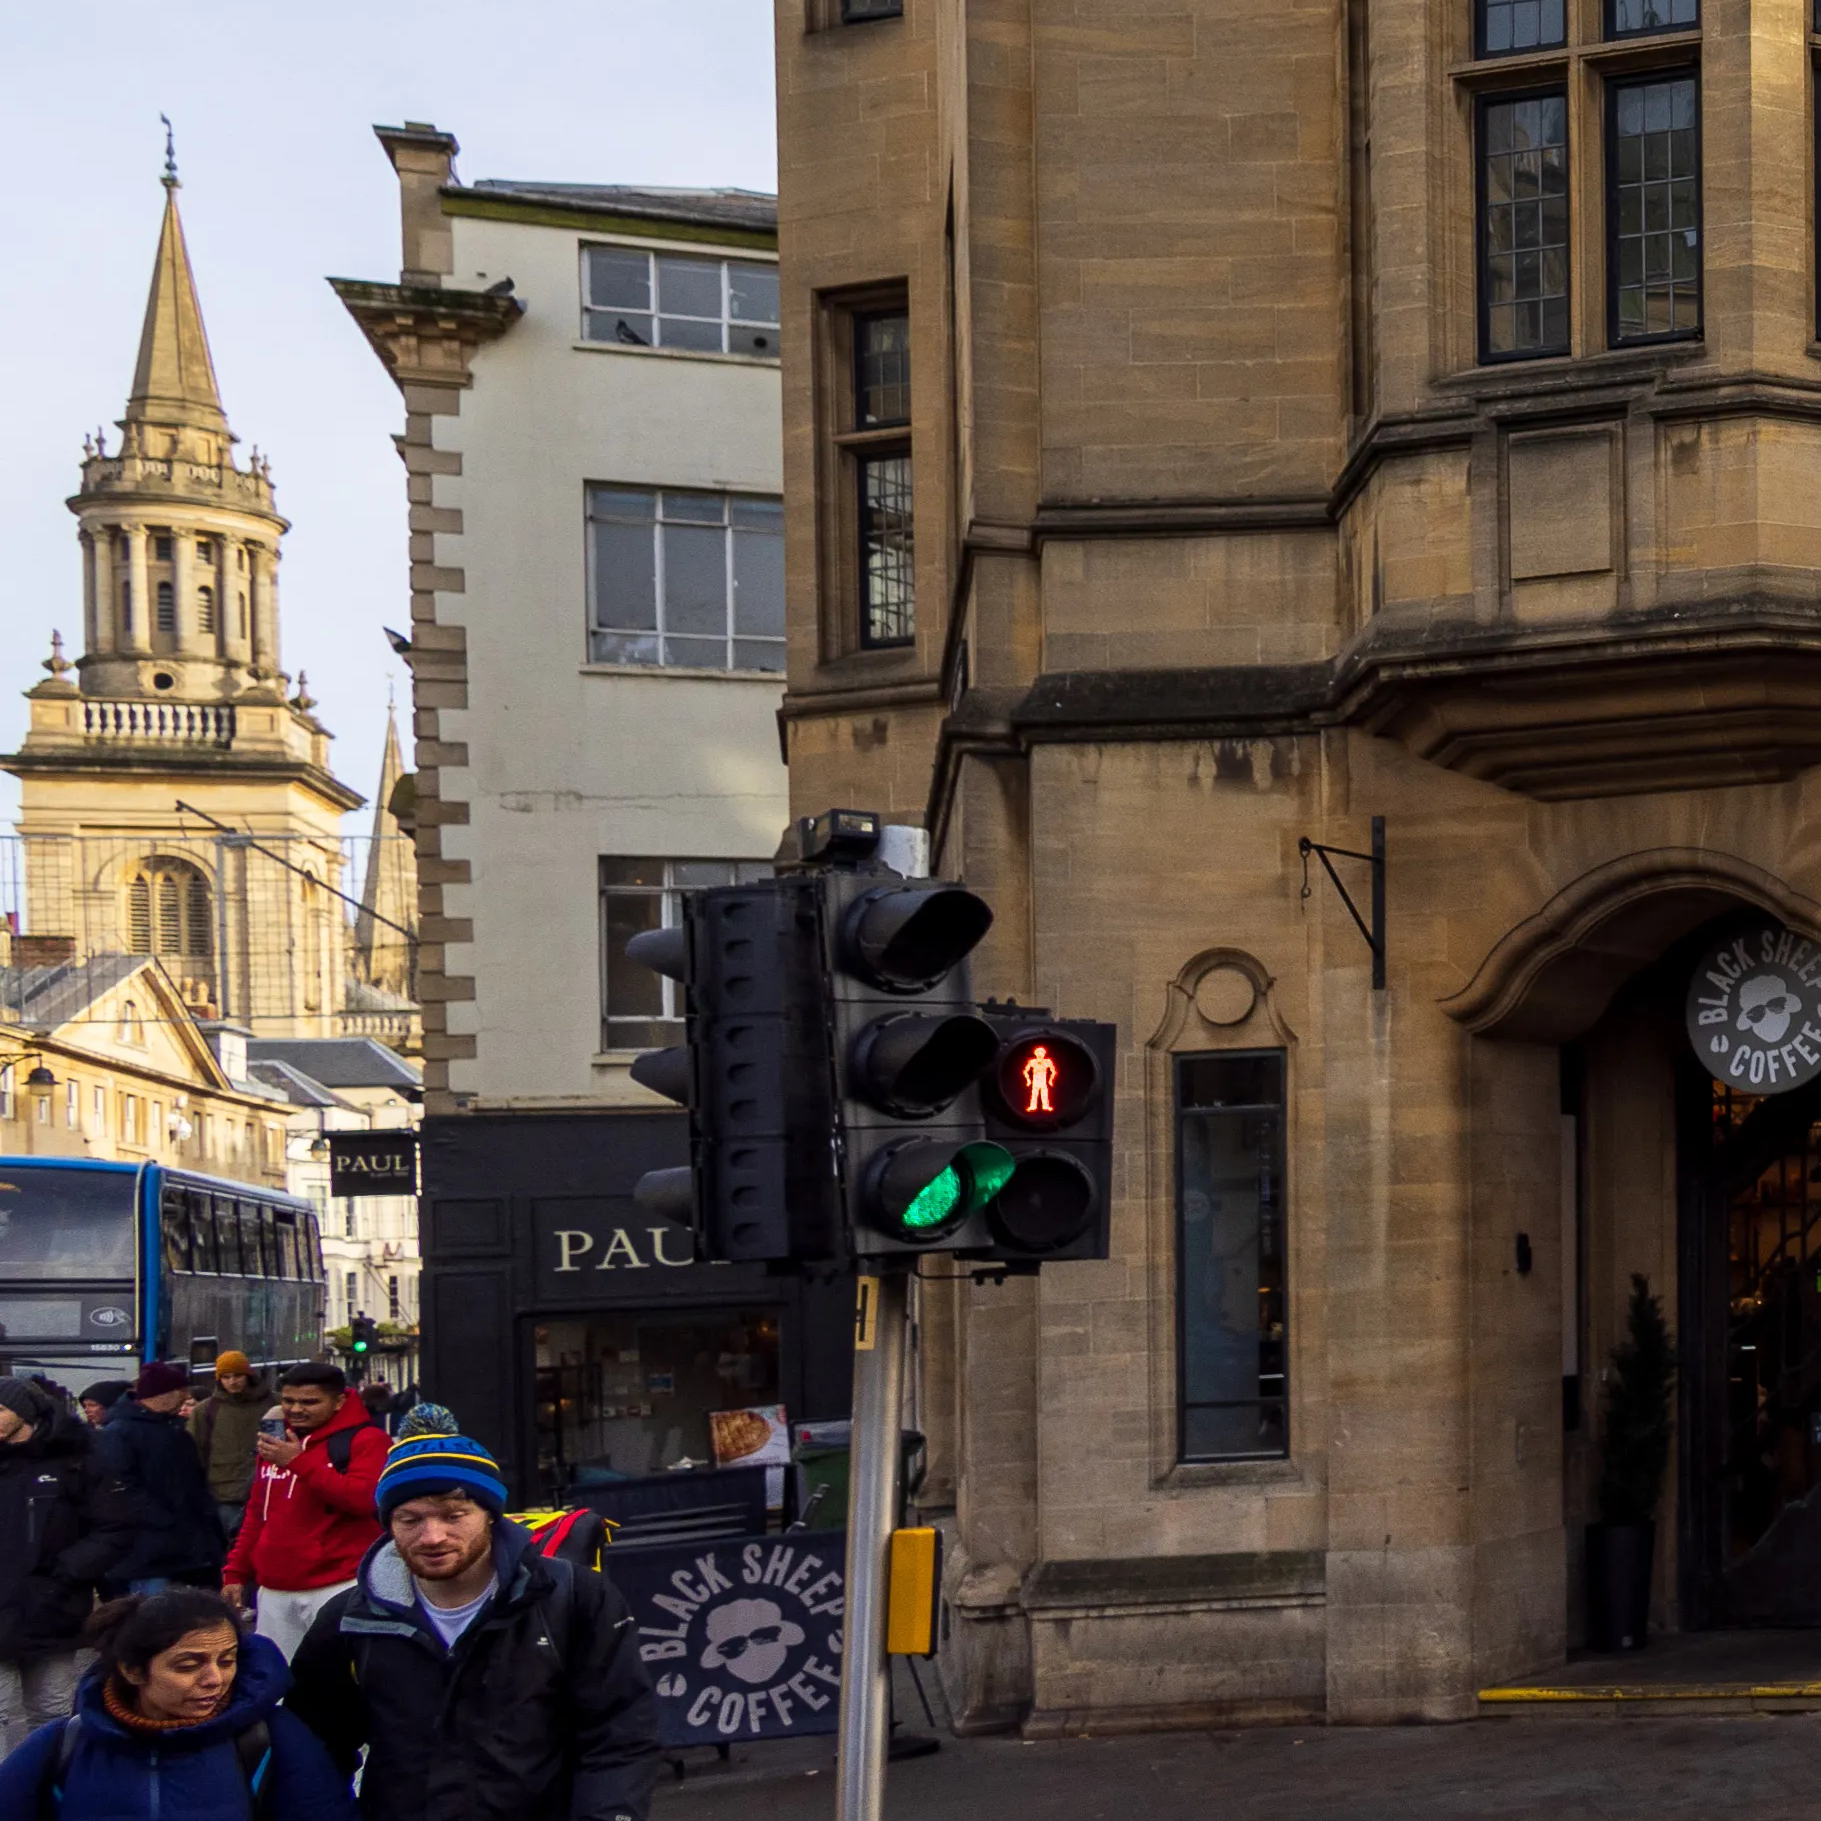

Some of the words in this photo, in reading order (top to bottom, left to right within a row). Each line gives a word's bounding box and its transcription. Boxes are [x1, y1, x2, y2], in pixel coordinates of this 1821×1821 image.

[1697, 938, 1756, 1026] BLACK
[335, 1154, 410, 1173] PAUL
[553, 1226, 732, 1272] PAU
[637, 1552, 734, 1662] BLACK
